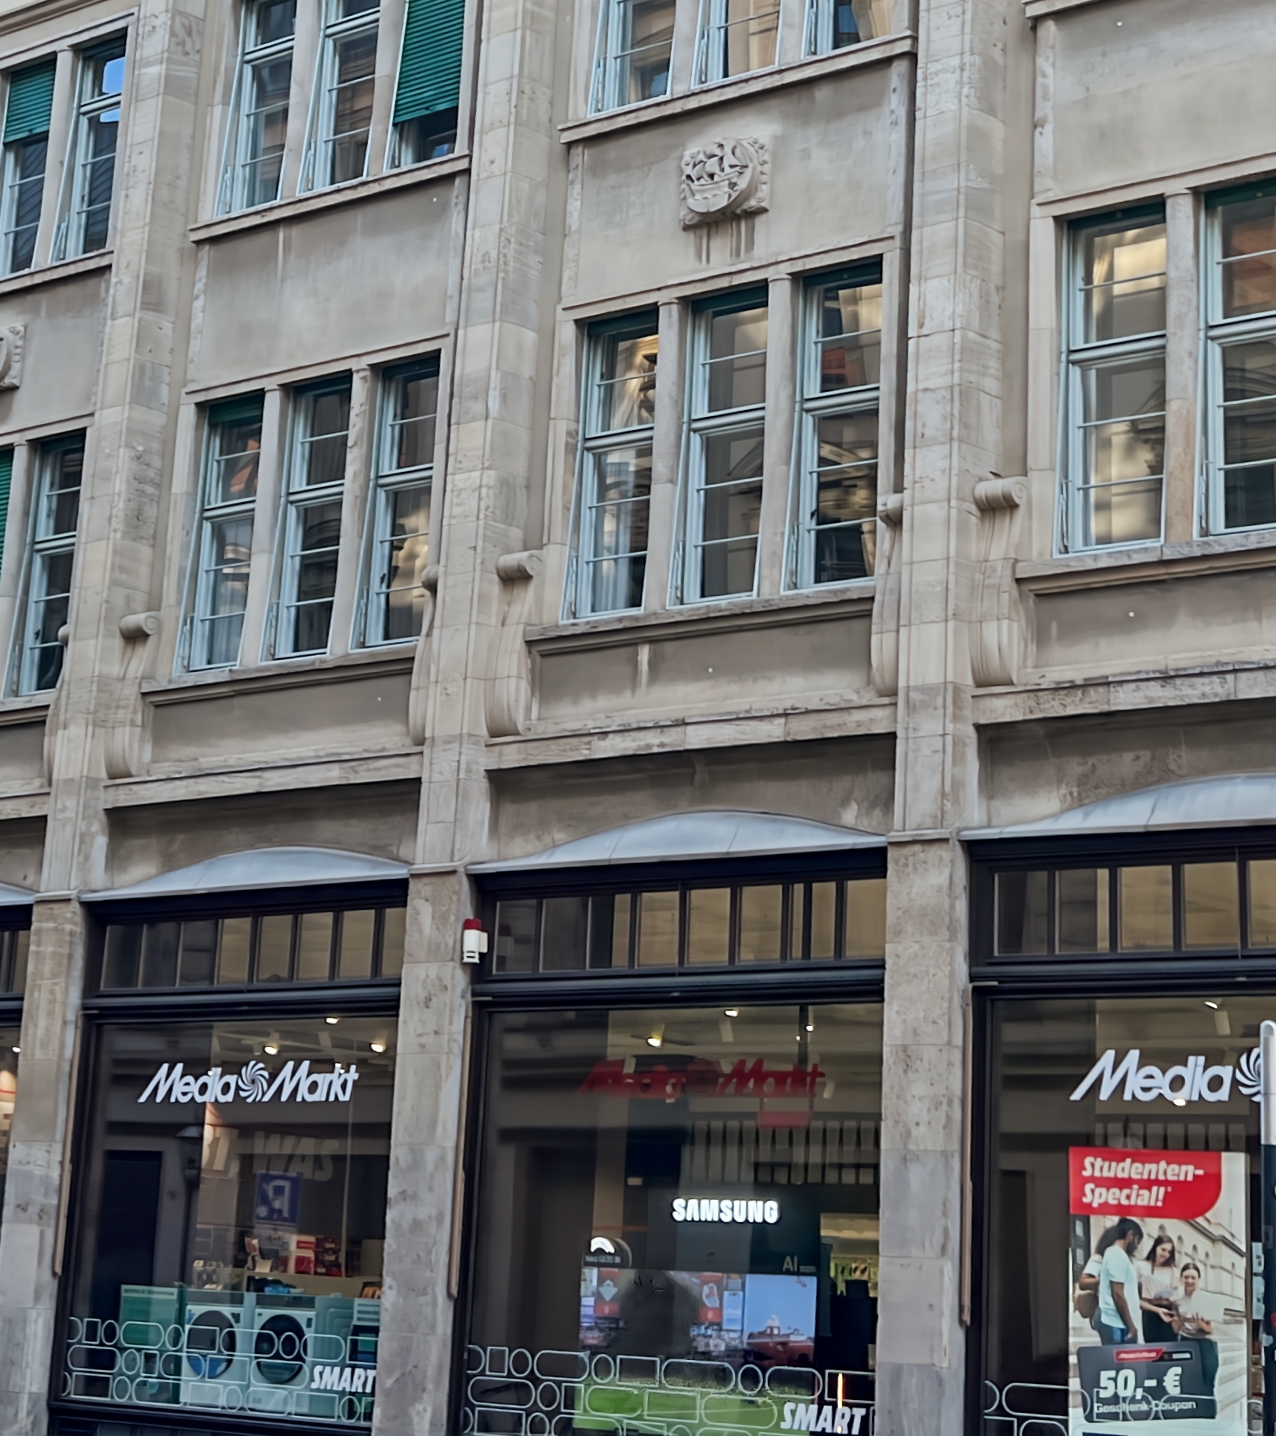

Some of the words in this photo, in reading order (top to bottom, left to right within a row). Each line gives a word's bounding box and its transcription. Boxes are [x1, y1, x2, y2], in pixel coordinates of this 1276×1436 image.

[137, 1063, 239, 1104] Media
[260, 1060, 360, 1103] Markt
[1069, 1048, 1234, 1102] Media
[1081, 1156, 1204, 1182] Studenten-
[672, 1198, 779, 1224] SAMSUNG
[1162, 1366, 1183, 1395] €
[780, 1402, 867, 1436] SMART
